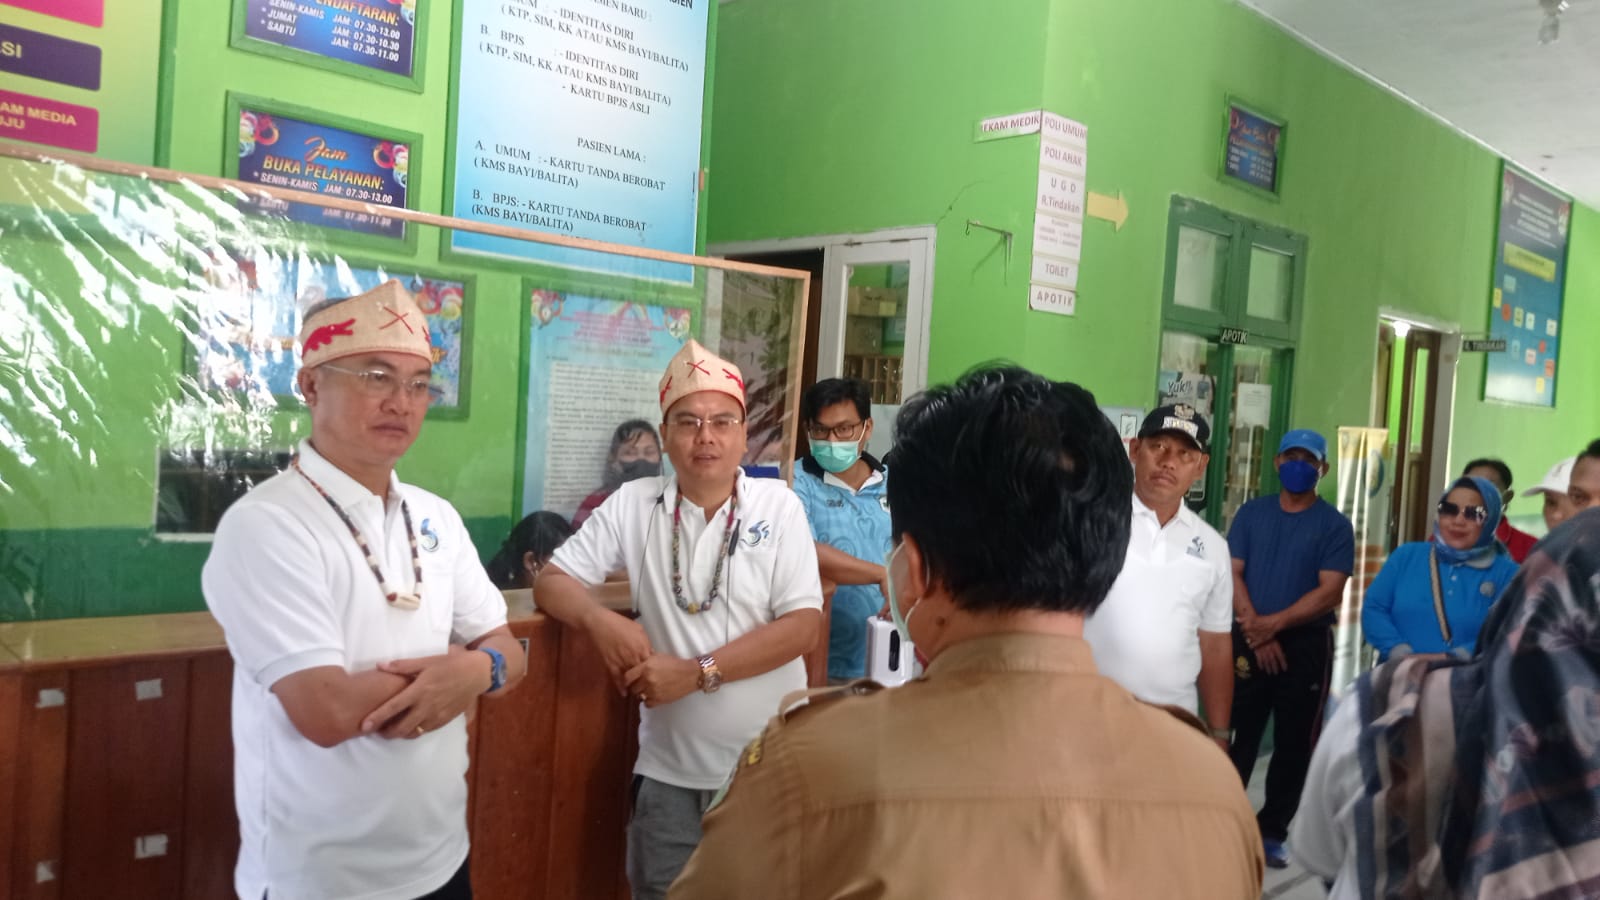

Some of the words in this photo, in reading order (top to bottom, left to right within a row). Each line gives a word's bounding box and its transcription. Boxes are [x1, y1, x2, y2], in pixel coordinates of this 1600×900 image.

[267, 9, 297, 23] JUMAT
[267, 21, 296, 36] SABTU
[560, 8, 612, 33] IDENTITAS
[614, 25, 634, 40] DIRI
[558, 20, 573, 34] KK
[575, 28, 603, 44] ATAU
[605, 36, 627, 51] KMS
[537, 58, 553, 72] KK
[555, 65, 584, 80] ATAU
[586, 72, 608, 87] KMS
[565, 50, 618, 73] IDENTITAS
[619, 66, 639, 81] DIRI
[570, 83, 605, 102] KARTU
[629, 101, 651, 115] ASLI
[27, 106, 77, 126] MEDIA
[480, 156, 506, 172] KMS
[577, 137, 613, 155] PASIEN
[614, 145, 641, 162] LAMA
[263, 155, 301, 175] BUKA
[305, 163, 385, 190] PELAYANAN:
[495, 143, 531, 161] UMUM
[549, 156, 585, 173] KARTU
[587, 165, 622, 182] TANDA
[622, 173, 666, 191] BEROBAT
[260, 172, 319, 192] SENIN-KAMIS
[346, 189, 393, 205] 07.30-13.00
[528, 199, 565, 216] KARTU
[567, 208, 601, 224] TANDA
[603, 214, 647, 232] BEROBAT
[1036, 290, 1074, 308] APOTIK
[1222, 328, 1248, 345] APOTIK
